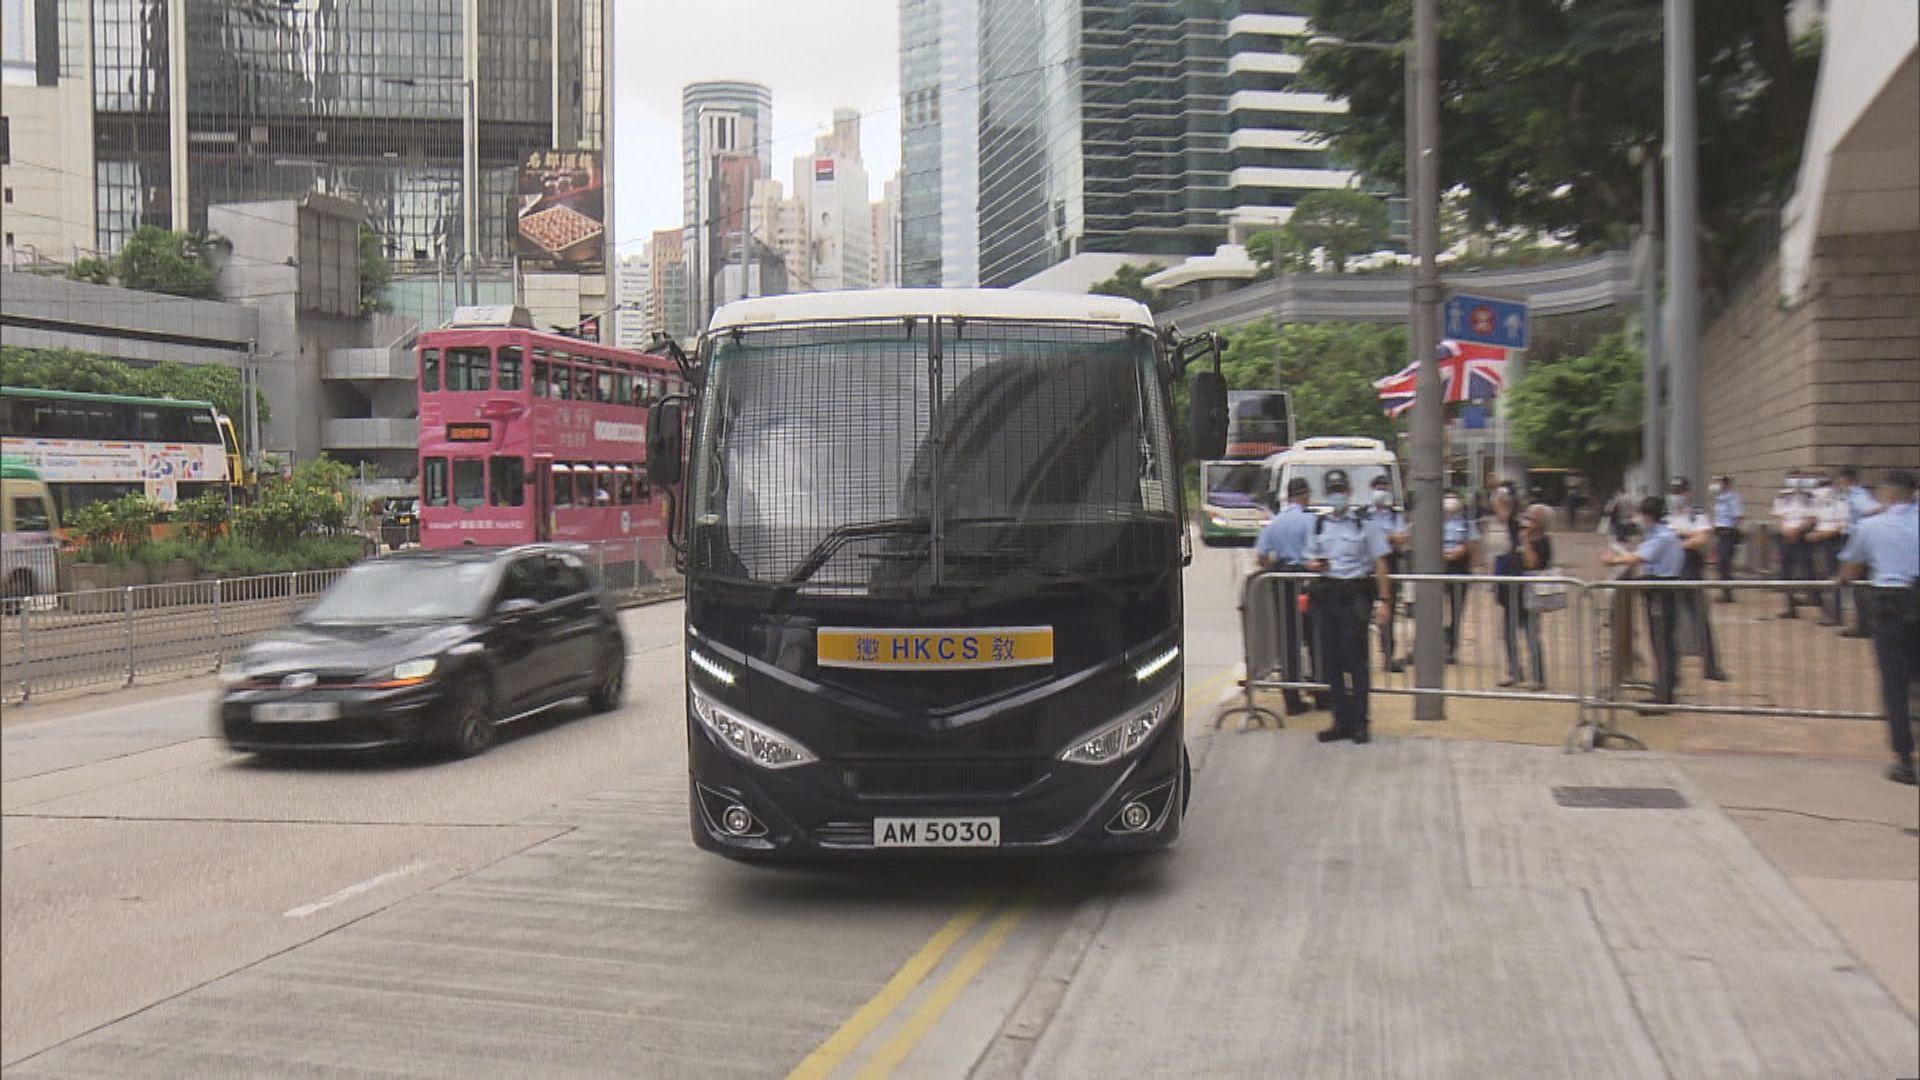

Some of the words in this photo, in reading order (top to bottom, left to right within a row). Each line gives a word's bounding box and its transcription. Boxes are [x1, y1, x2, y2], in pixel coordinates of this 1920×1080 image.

[856, 637, 879, 661] 懲
[892, 636, 979, 660] HKCS
[883, 822, 916, 843] AM
[925, 822, 992, 842] 5030
